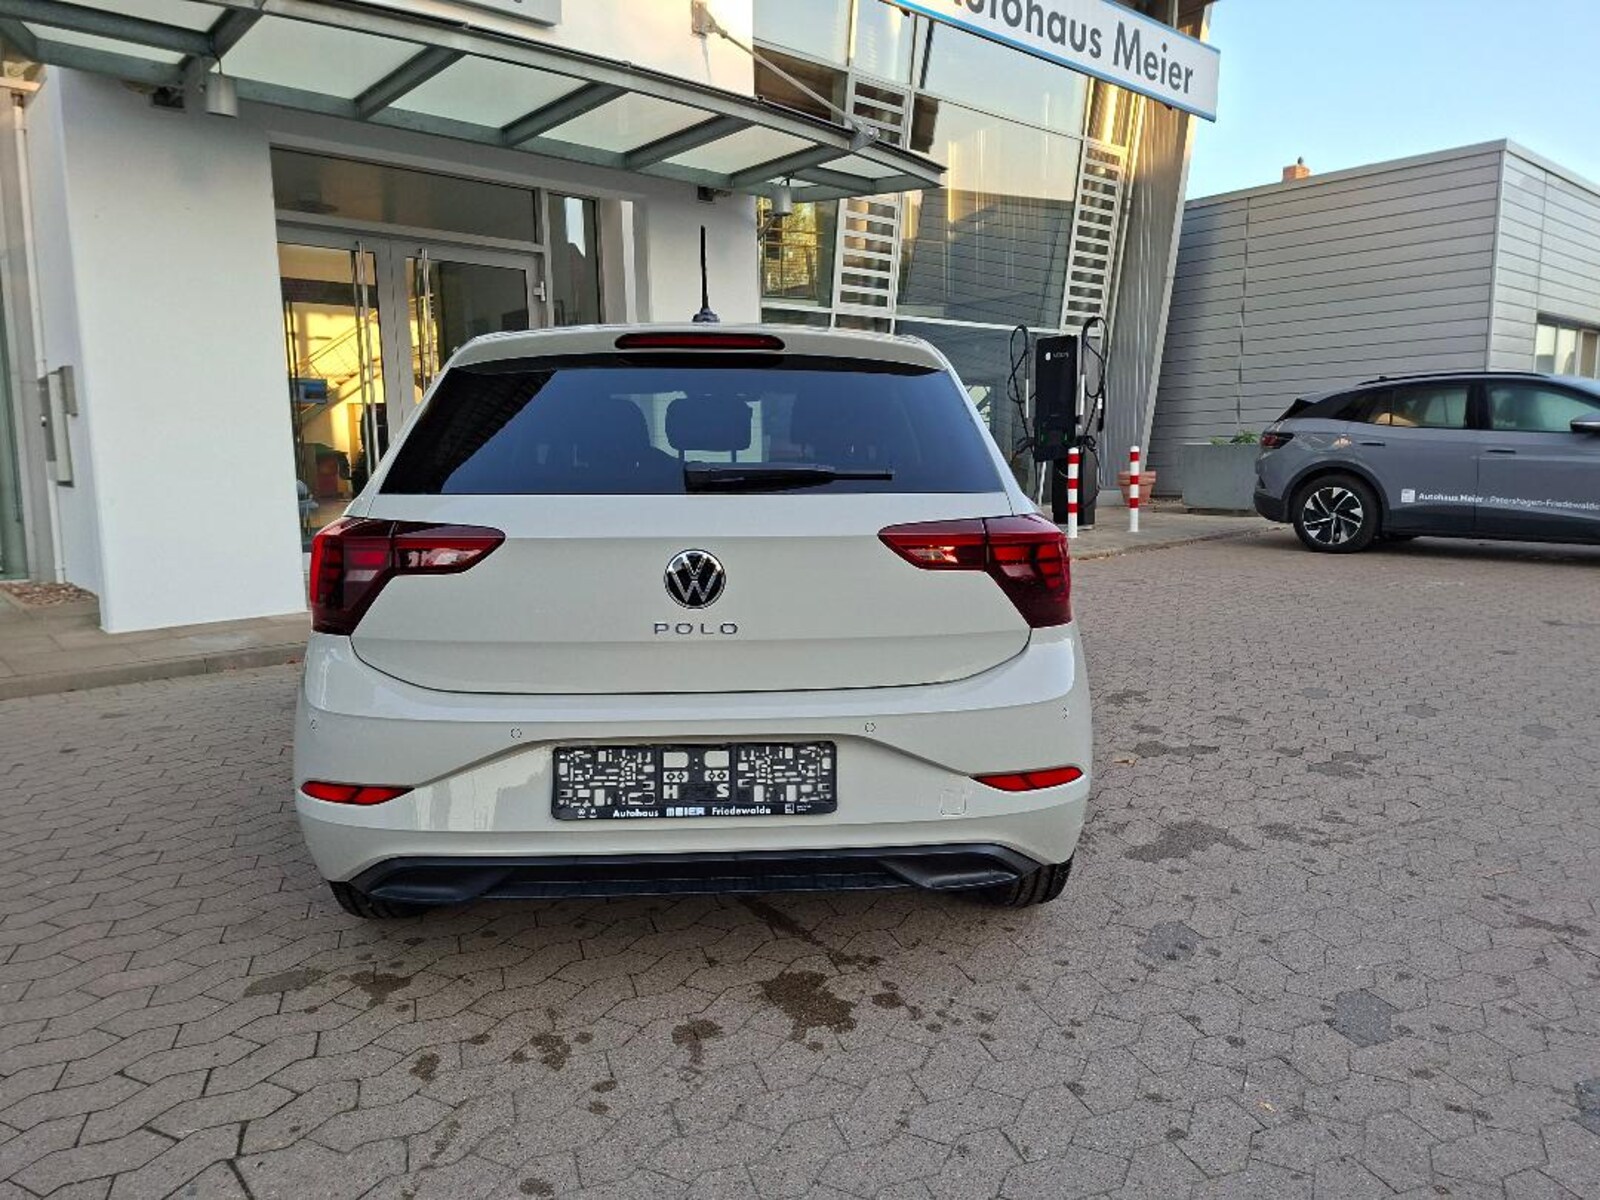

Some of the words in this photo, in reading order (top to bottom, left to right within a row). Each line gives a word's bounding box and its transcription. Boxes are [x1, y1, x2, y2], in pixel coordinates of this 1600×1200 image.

[954, 0, 1103, 59] ohaus
[1113, 20, 1194, 94] Meier
[1419, 493, 1459, 501] Autohaus
[1460, 494, 1483, 503] Meier
[664, 549, 726, 609] VW
[654, 623, 738, 635] POLO
[663, 784, 679, 800] H
[716, 784, 730, 798] S
[613, 808, 659, 818] Autohaus
[666, 806, 706, 817] MEIER
[711, 805, 772, 816] Friedewalde
